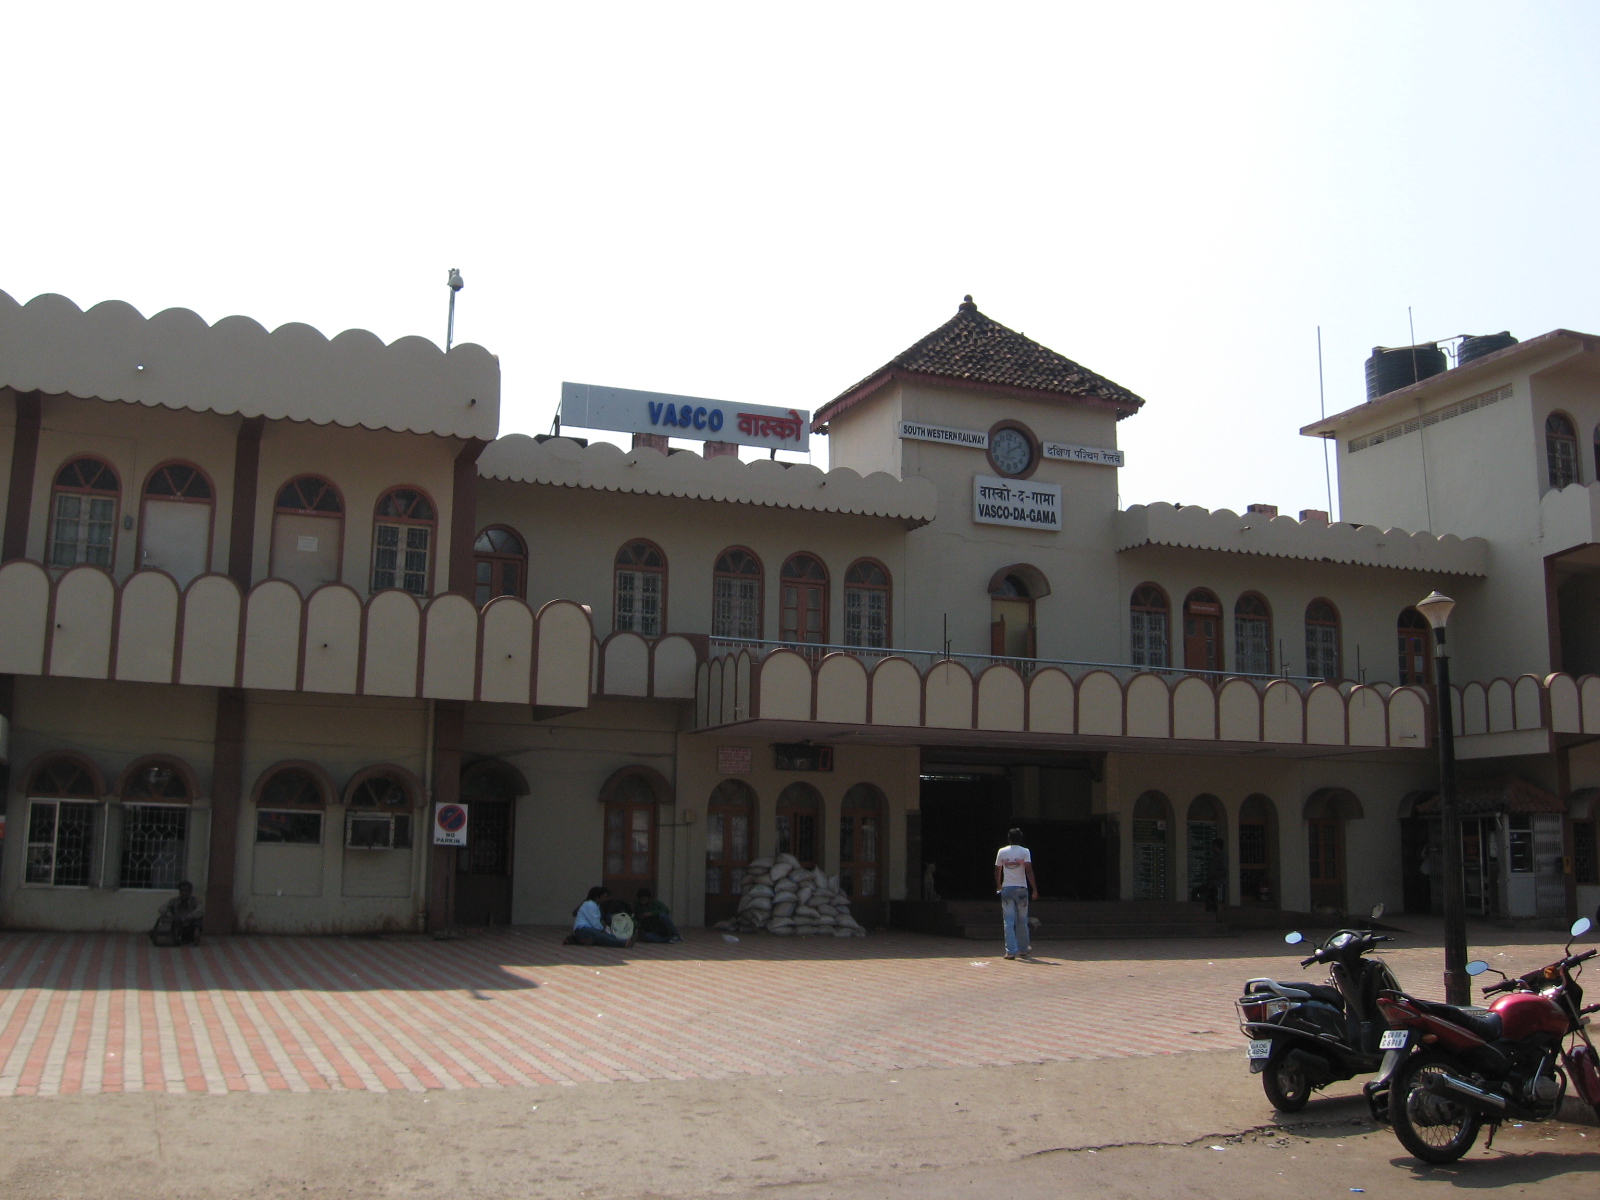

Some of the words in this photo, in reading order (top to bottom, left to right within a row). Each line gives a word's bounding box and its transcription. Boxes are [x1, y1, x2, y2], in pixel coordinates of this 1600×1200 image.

[648, 401, 724, 432] VASCO
[737, 409, 803, 441] वास्को
[903, 425, 926, 437] SOUTH
[926, 428, 957, 441] WESTERN
[958, 433, 986, 445] RAILWAY
[1047, 445, 1071, 458] दक्षिण
[1075, 448, 1099, 461] पश्चिम
[1101, 451, 1121, 464] रेलवे
[979, 484, 1055, 506] वास्को-द-गामा
[978, 504, 1057, 525] VASCO-DA-GAMA
